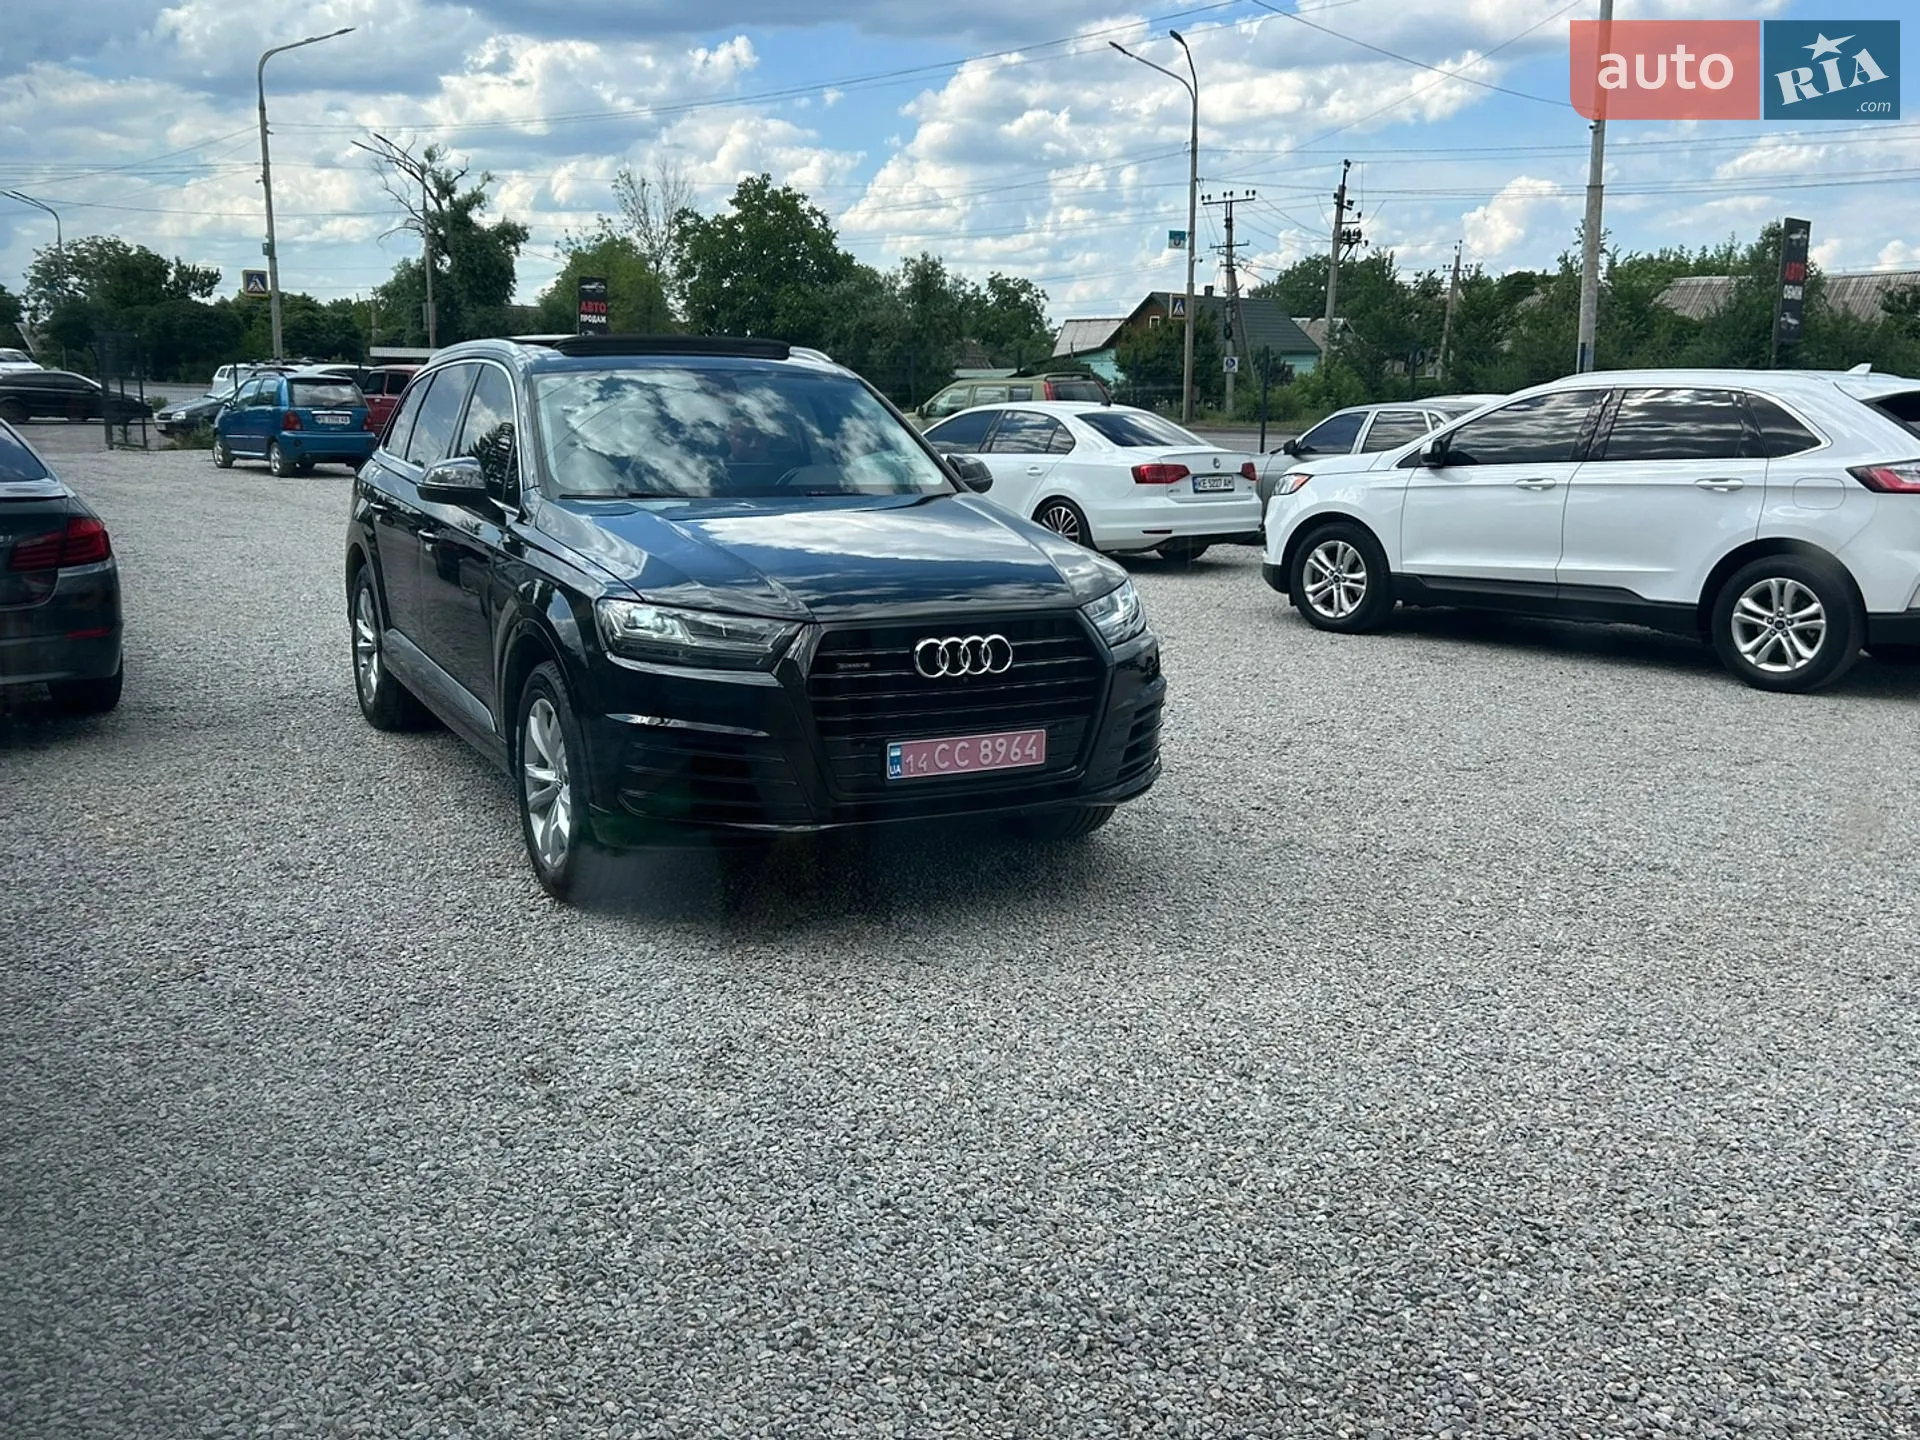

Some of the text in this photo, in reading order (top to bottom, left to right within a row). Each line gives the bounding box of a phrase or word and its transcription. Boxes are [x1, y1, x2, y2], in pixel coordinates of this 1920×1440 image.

[580, 300, 607, 314] АВТО
[905, 735, 1037, 773] 14 CC 8964
